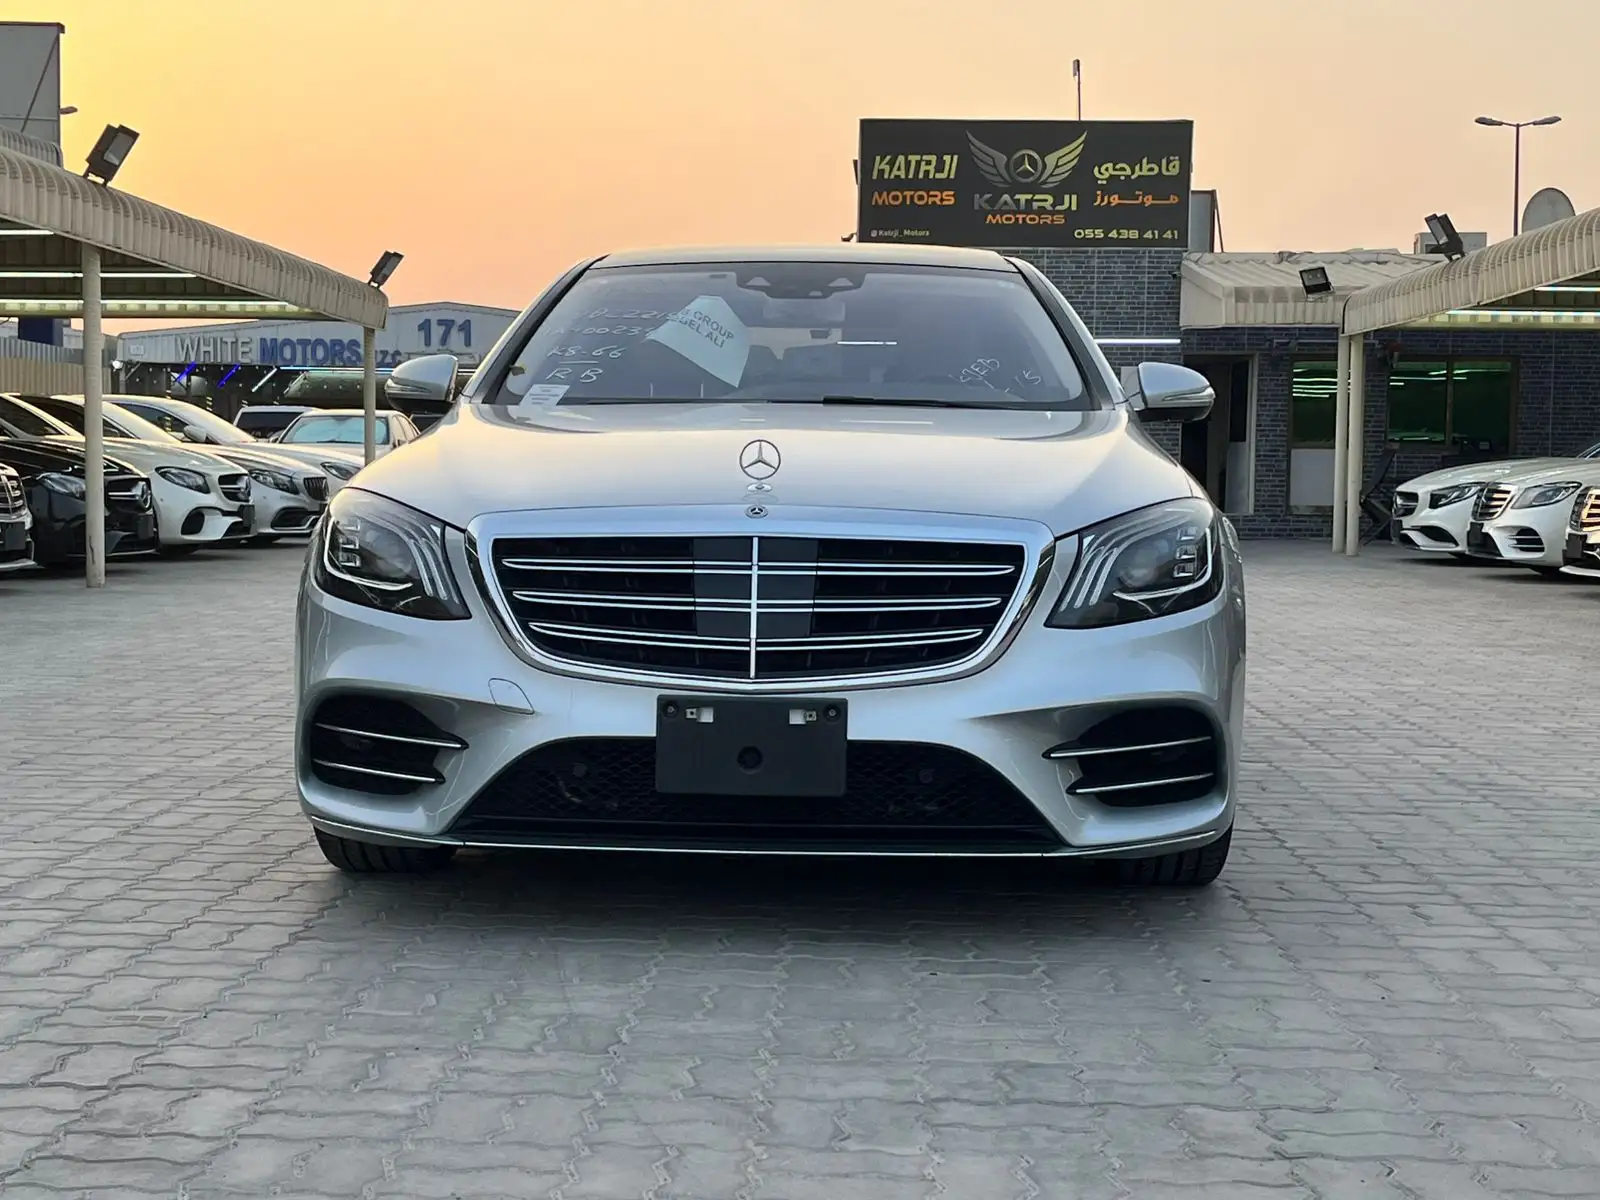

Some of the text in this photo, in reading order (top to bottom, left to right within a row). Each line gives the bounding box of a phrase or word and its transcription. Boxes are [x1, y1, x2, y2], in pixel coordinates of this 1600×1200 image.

[872, 154, 959, 179] KATRJI
[1093, 155, 1180, 184] قاطرجي
[871, 190, 956, 206] MOTORS
[973, 193, 1078, 211] KATRJI
[1093, 190, 1179, 207] موتورز
[985, 213, 1066, 225] MOTORS
[1073, 229, 1179, 240] 055 438 41 41
[417, 318, 472, 347] 171
[693, 310, 735, 341] GROUP
[704, 331, 726, 349] ALI
[176, 336, 253, 364] WHITE
[259, 337, 362, 367] MOTORS
